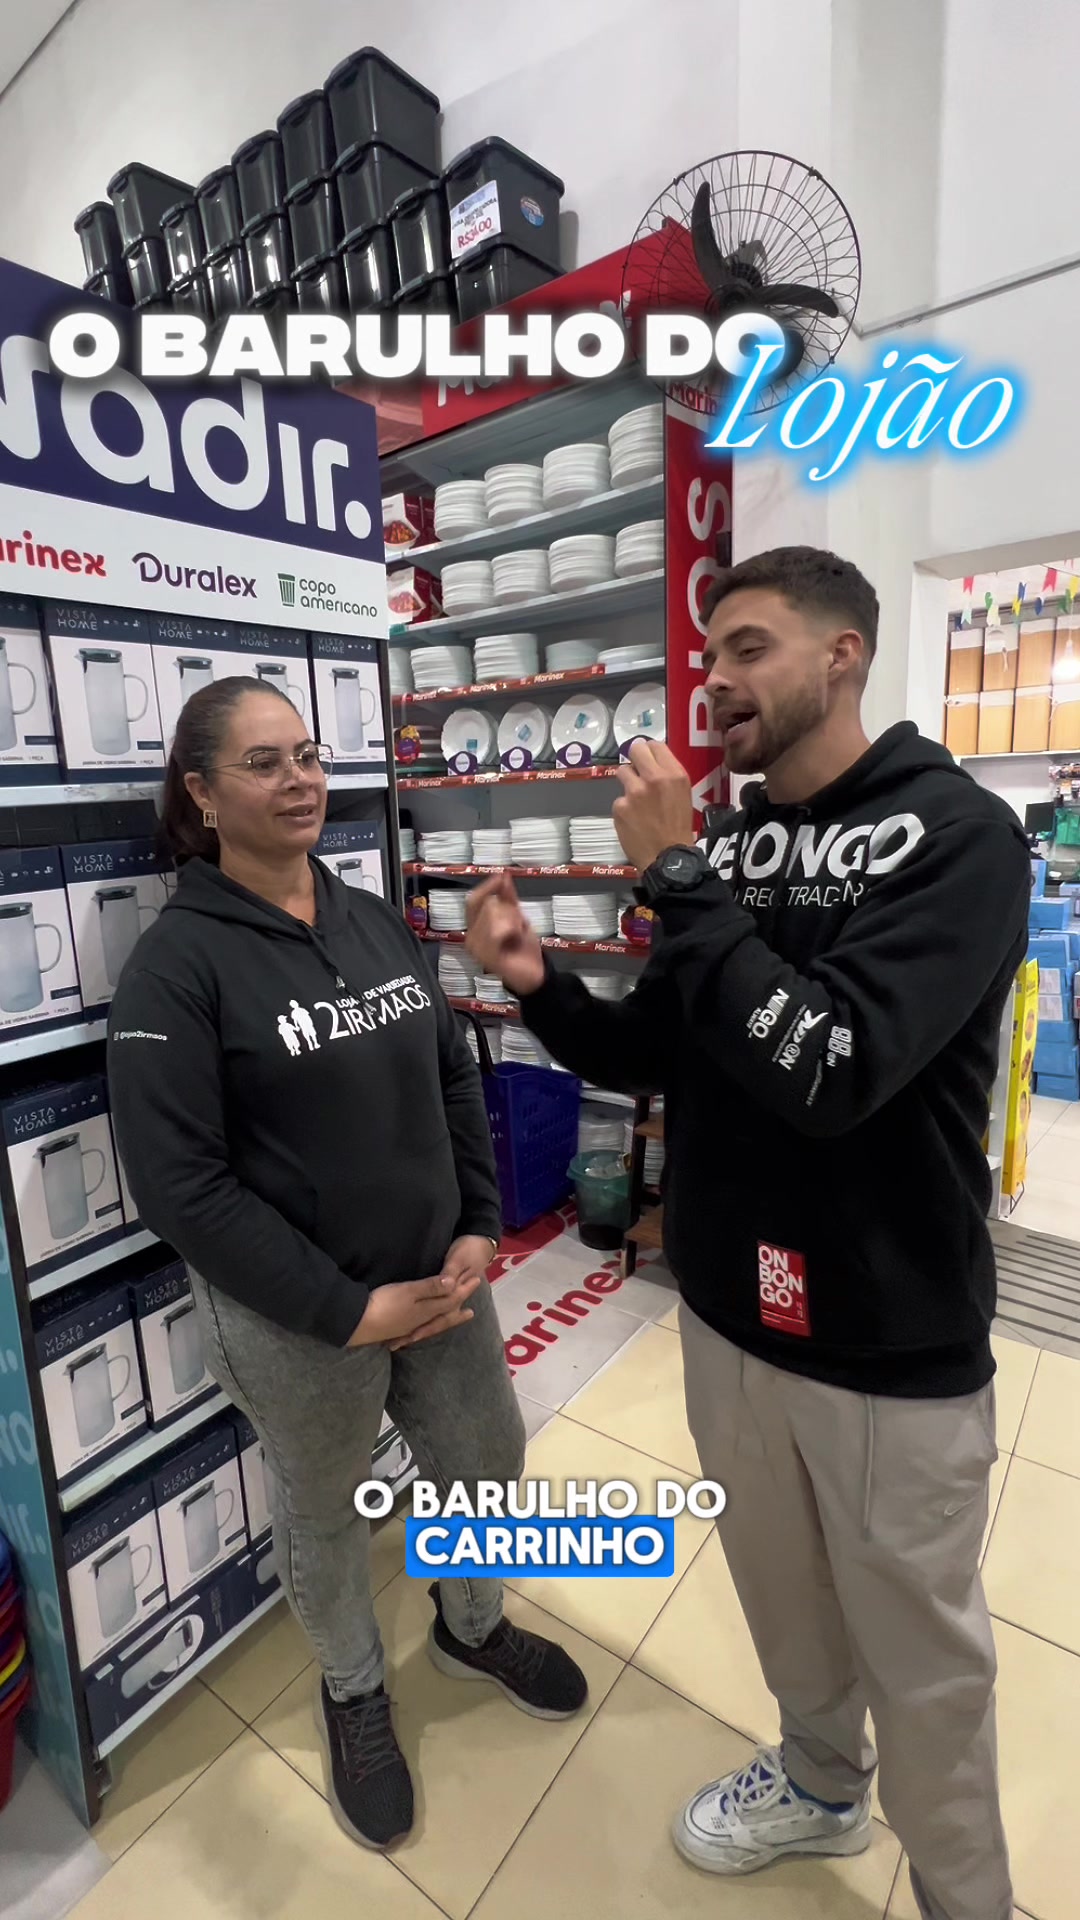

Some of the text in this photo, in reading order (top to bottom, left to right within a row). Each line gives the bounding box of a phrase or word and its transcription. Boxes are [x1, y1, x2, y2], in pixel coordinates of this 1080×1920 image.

[0, 530, 107, 577] rinex
[132, 552, 257, 598] Duralex
[299, 577, 336, 596] copo
[300, 595, 378, 618] americano
[56, 607, 98, 621] VISTA
[57, 618, 98, 631] HOME
[158, 620, 192, 631] VISTA
[159, 629, 193, 640] HOME
[240, 638, 270, 648] HOME
[319, 645, 344, 654] HOME
[534, 672, 564, 683] Marinex
[537, 772, 566, 780] Marinex
[323, 832, 348, 841] VISTA
[323, 840, 348, 848] HOME
[73, 854, 113, 865] VISTA
[74, 862, 113, 874] HOME
[592, 866, 625, 876] Marinex
[595, 943, 626, 953] Marinex
[364, 988, 379, 1000] DE
[13, 1107, 56, 1125] VISTA
[15, 1115, 56, 1134] HOME
[759, 1246, 788, 1271] ON
[759, 1263, 803, 1294] BON
[760, 1284, 793, 1308] GO
[504, 1249, 648, 1377] arine
